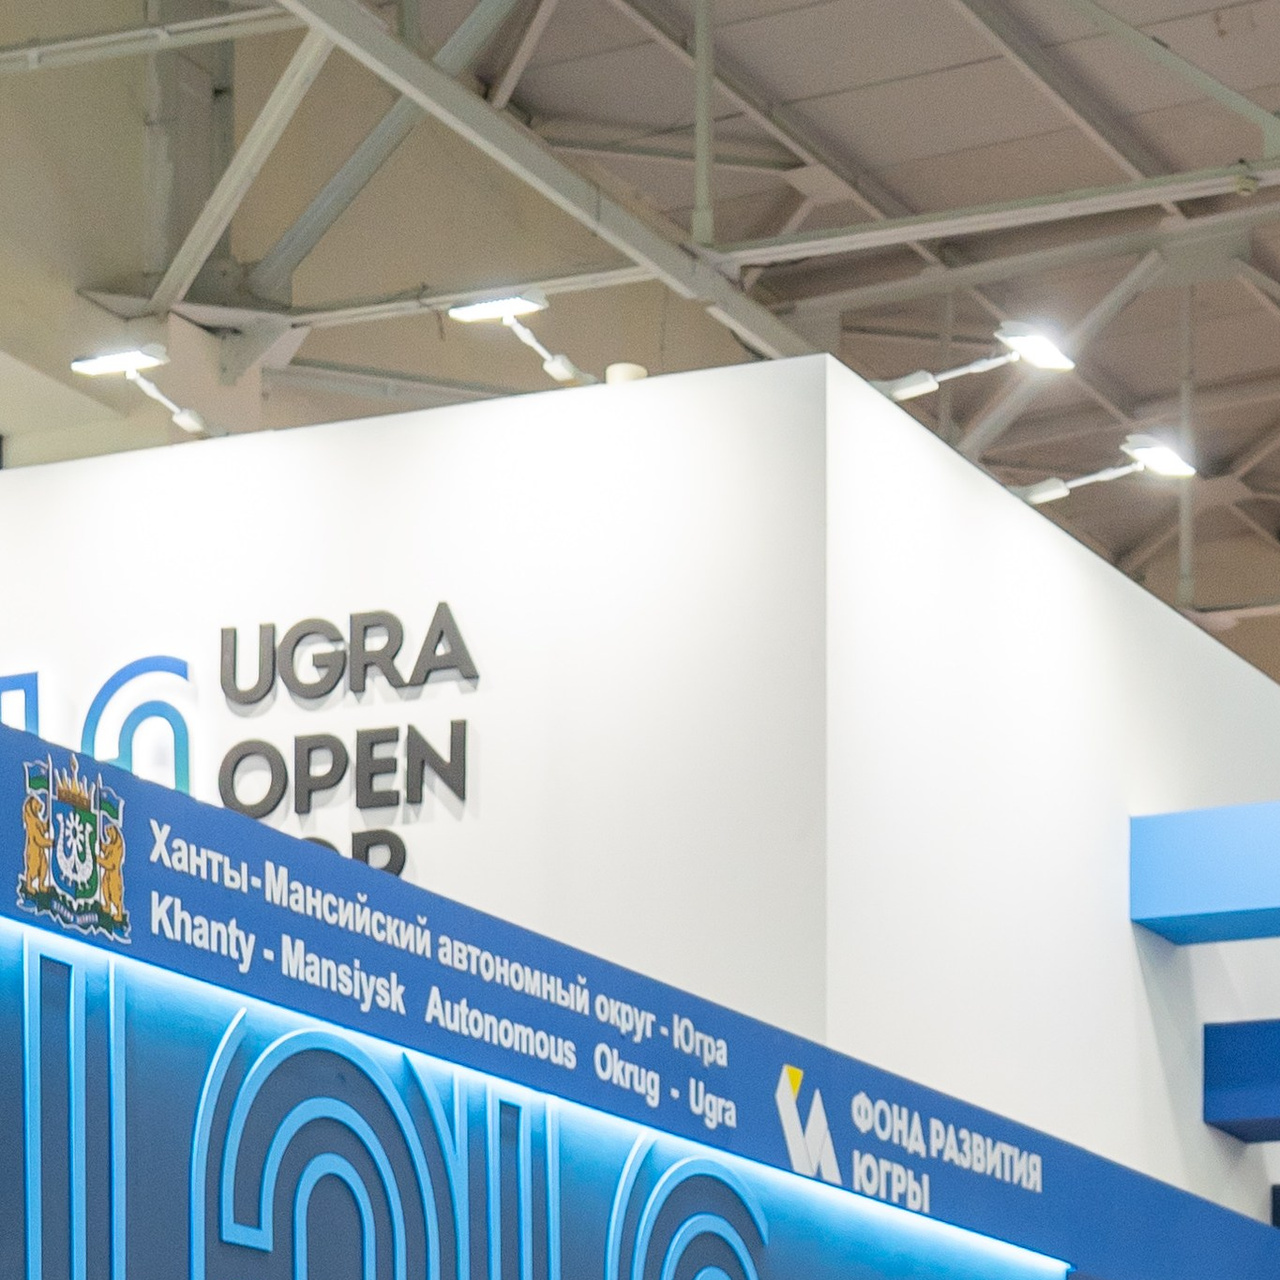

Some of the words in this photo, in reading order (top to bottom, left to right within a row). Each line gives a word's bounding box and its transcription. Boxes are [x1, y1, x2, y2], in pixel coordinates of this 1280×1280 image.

[220, 601, 479, 705] UGRA
[219, 719, 467, 820] OPEN
[151, 891, 255, 974] Khanty
[281, 934, 406, 1015] Mansiysk
[425, 986, 577, 1070] Autonomous
[594, 1043, 660, 1108] Okrug
[690, 1078, 737, 1129] Ugra
[438, 934, 590, 1016] автономный
[595, 994, 656, 1044] округ
[673, 1014, 728, 1068] Югра
[852, 1091, 926, 1158] ФОНД
[930, 1117, 1042, 1193] РАЗВИТИЯ
[853, 1149, 930, 1214] ЮГРЫ
